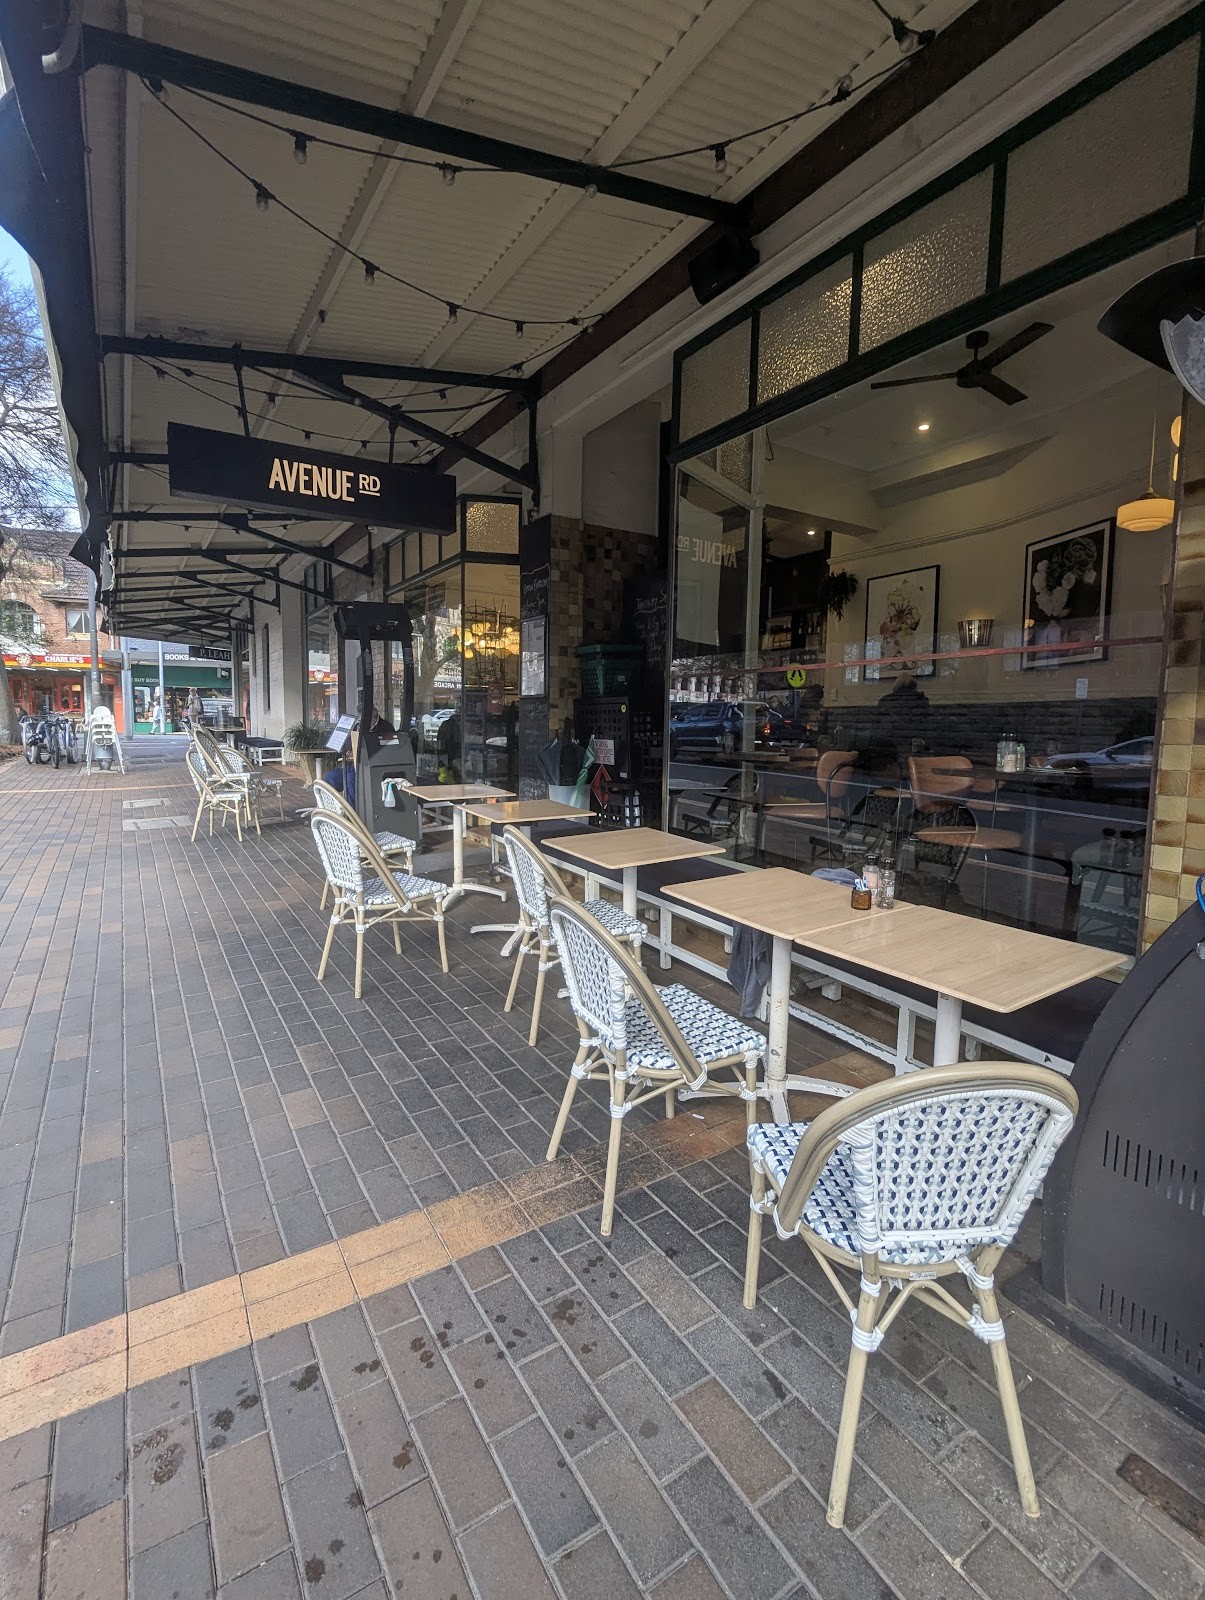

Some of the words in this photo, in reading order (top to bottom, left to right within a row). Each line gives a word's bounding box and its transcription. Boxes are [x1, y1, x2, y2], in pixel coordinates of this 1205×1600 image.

[268, 457, 355, 502] AVENUE
[359, 474, 381, 494] RD
[45, 655, 84, 663] CHARLIE'S
[164, 653, 189, 661] BOOKS
[208, 650, 232, 660] LEAH
